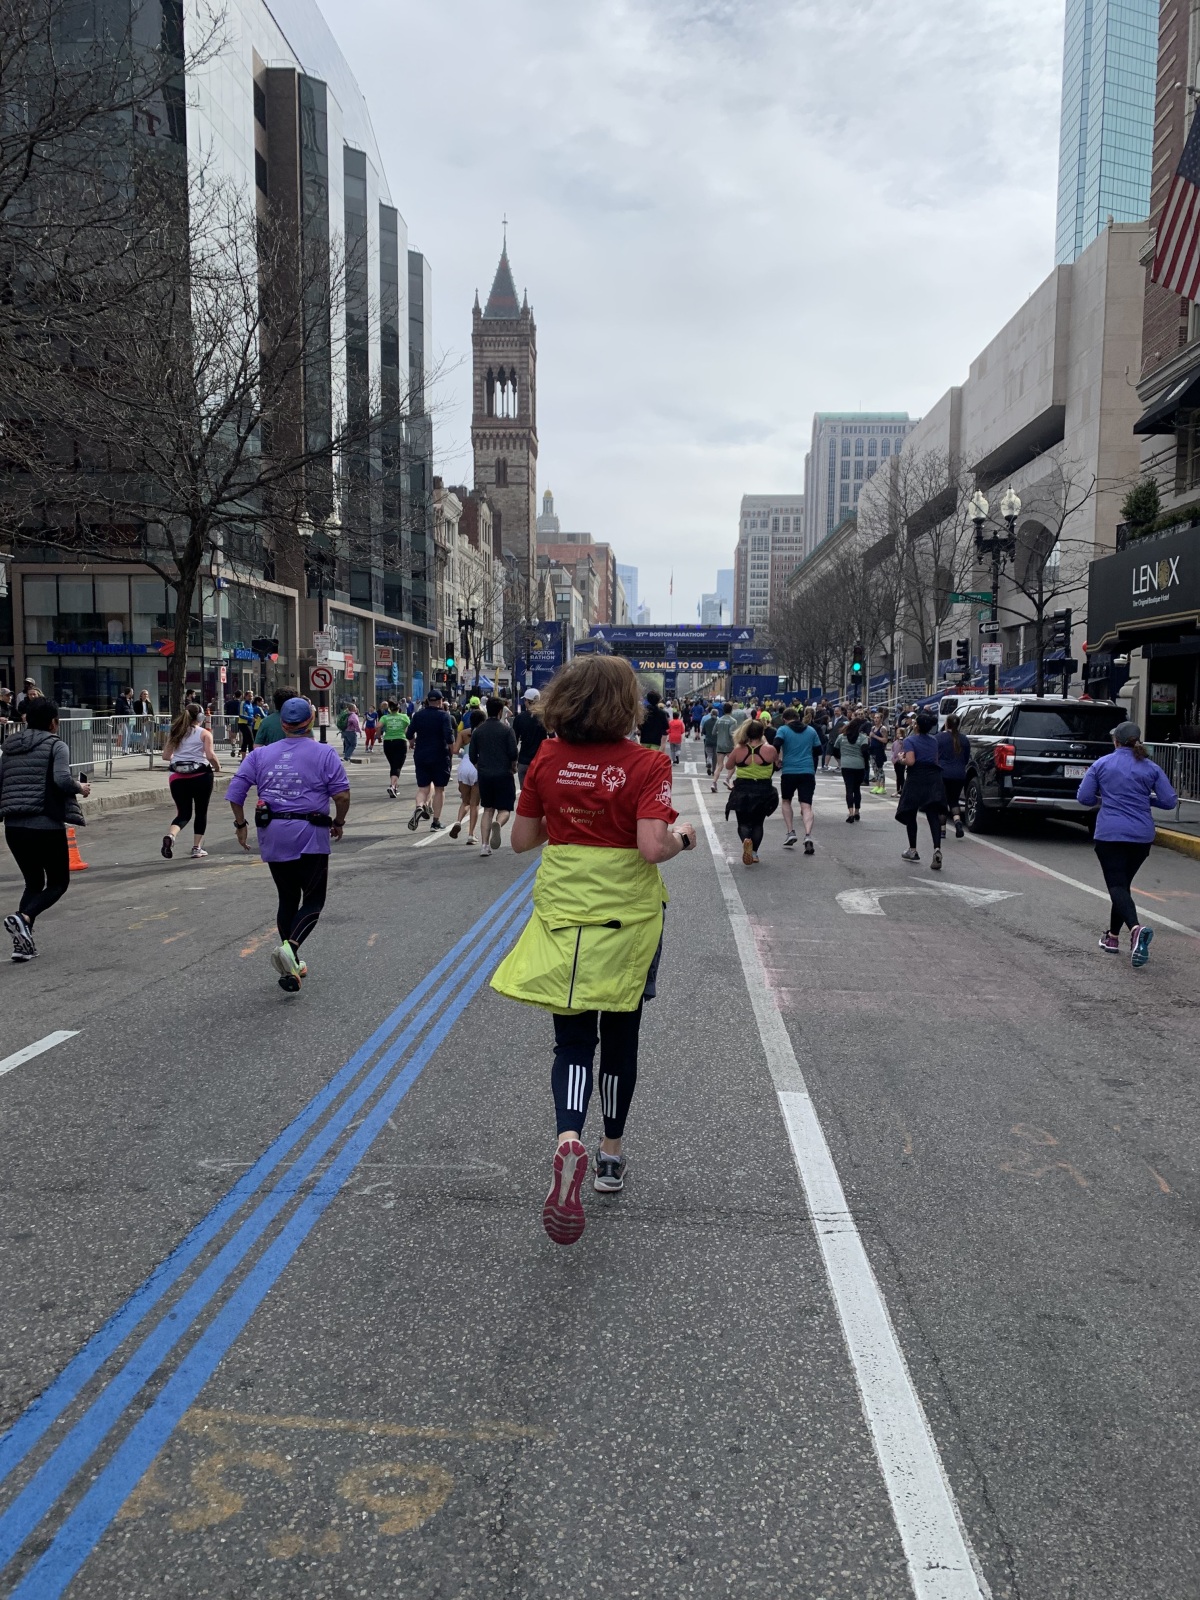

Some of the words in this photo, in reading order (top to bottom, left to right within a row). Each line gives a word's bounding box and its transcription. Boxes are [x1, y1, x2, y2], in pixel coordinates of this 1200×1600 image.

[1132, 556, 1180, 595] LENOX
[639, 661, 655, 669] 7/10
[567, 762, 599, 771] Special
[559, 769, 597, 779] Olympics
[556, 778, 596, 788] Massachusetts
[566, 806, 596, 817] Memory
[571, 816, 594, 826] Kenny
